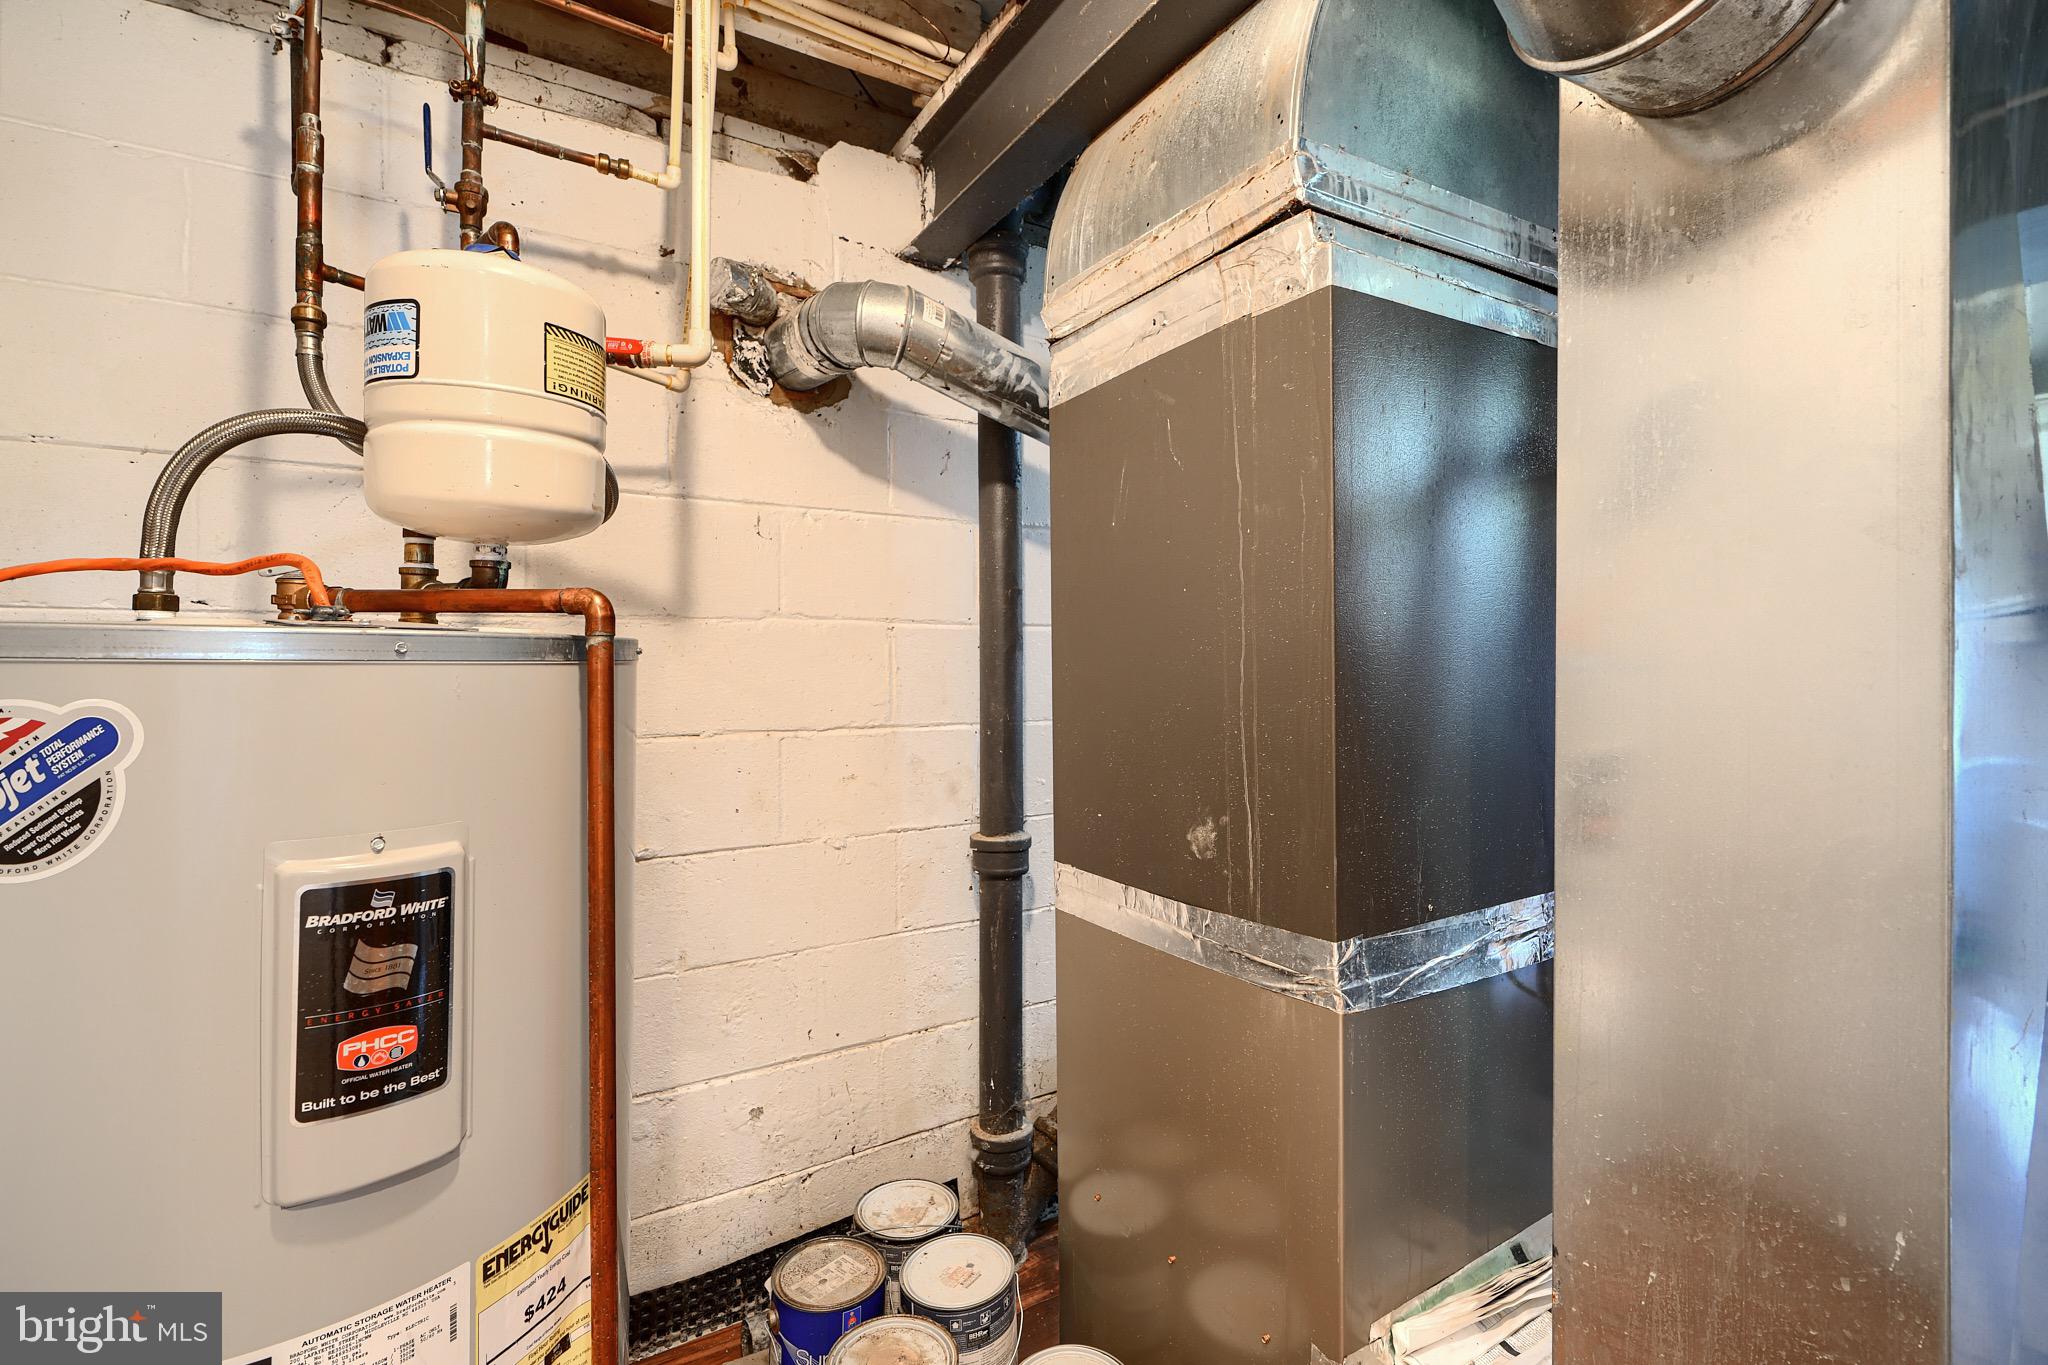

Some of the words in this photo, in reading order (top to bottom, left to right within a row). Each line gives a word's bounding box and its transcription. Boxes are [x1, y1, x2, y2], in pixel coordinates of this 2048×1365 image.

[368, 352, 410, 364] EXPANSION
[374, 364, 409, 375] POTABLE
[552, 382, 605, 409] ARNING!
[9, 735, 40, 756] WITH
[39, 739, 66, 758] TOTAL
[46, 724, 105, 766] PERFORMANCE
[51, 749, 84, 774] SYSTEM
[4, 831, 31, 852] Reduced
[28, 812, 60, 834] Sediment
[57, 798, 82, 816] Buildup
[17, 840, 38, 856] Lower
[36, 821, 68, 843] Operating
[65, 809, 84, 823] Costs
[46, 843, 80, 866] WHITE
[84, 770, 114, 841] CORPORATION
[34, 843, 52, 856] More
[50, 834, 64, 846] Hot
[61, 822, 82, 838] Water
[305, 907, 396, 928] BRADFORD
[400, 897, 447, 916] WHITE
[317, 911, 437, 935] CORPORATION
[306, 1007, 382, 1026] ENERGY
[394, 991, 445, 1010] SAVER
[343, 1029, 415, 1056] PHCC
[341, 1074, 368, 1085] OFFICIAL
[369, 1070, 390, 1079] WATER
[390, 1062, 413, 1074] HEATER
[302, 1098, 336, 1112] Built
[339, 1095, 356, 1106] to
[360, 1088, 380, 1100] be
[383, 1080, 407, 1094] the
[516, 1278, 537, 1297] Estimated
[538, 1268, 549, 1281] Yearly
[550, 1258, 561, 1272] Energy
[562, 1250, 571, 1261] Cost
[302, 1323, 352, 1348] AUTOMATIC
[354, 1305, 394, 1327] STORAGE
[395, 1292, 422, 1310] WATER
[424, 1276, 452, 1296] HEATER
[524, 1276, 566, 1323] $424
[290, 1346, 318, 1360] BRADFORD
[320, 1337, 338, 1348] WHITE
[342, 1320, 378, 1340] CORPORATION
[968, 1331, 984, 1340] BEHR
